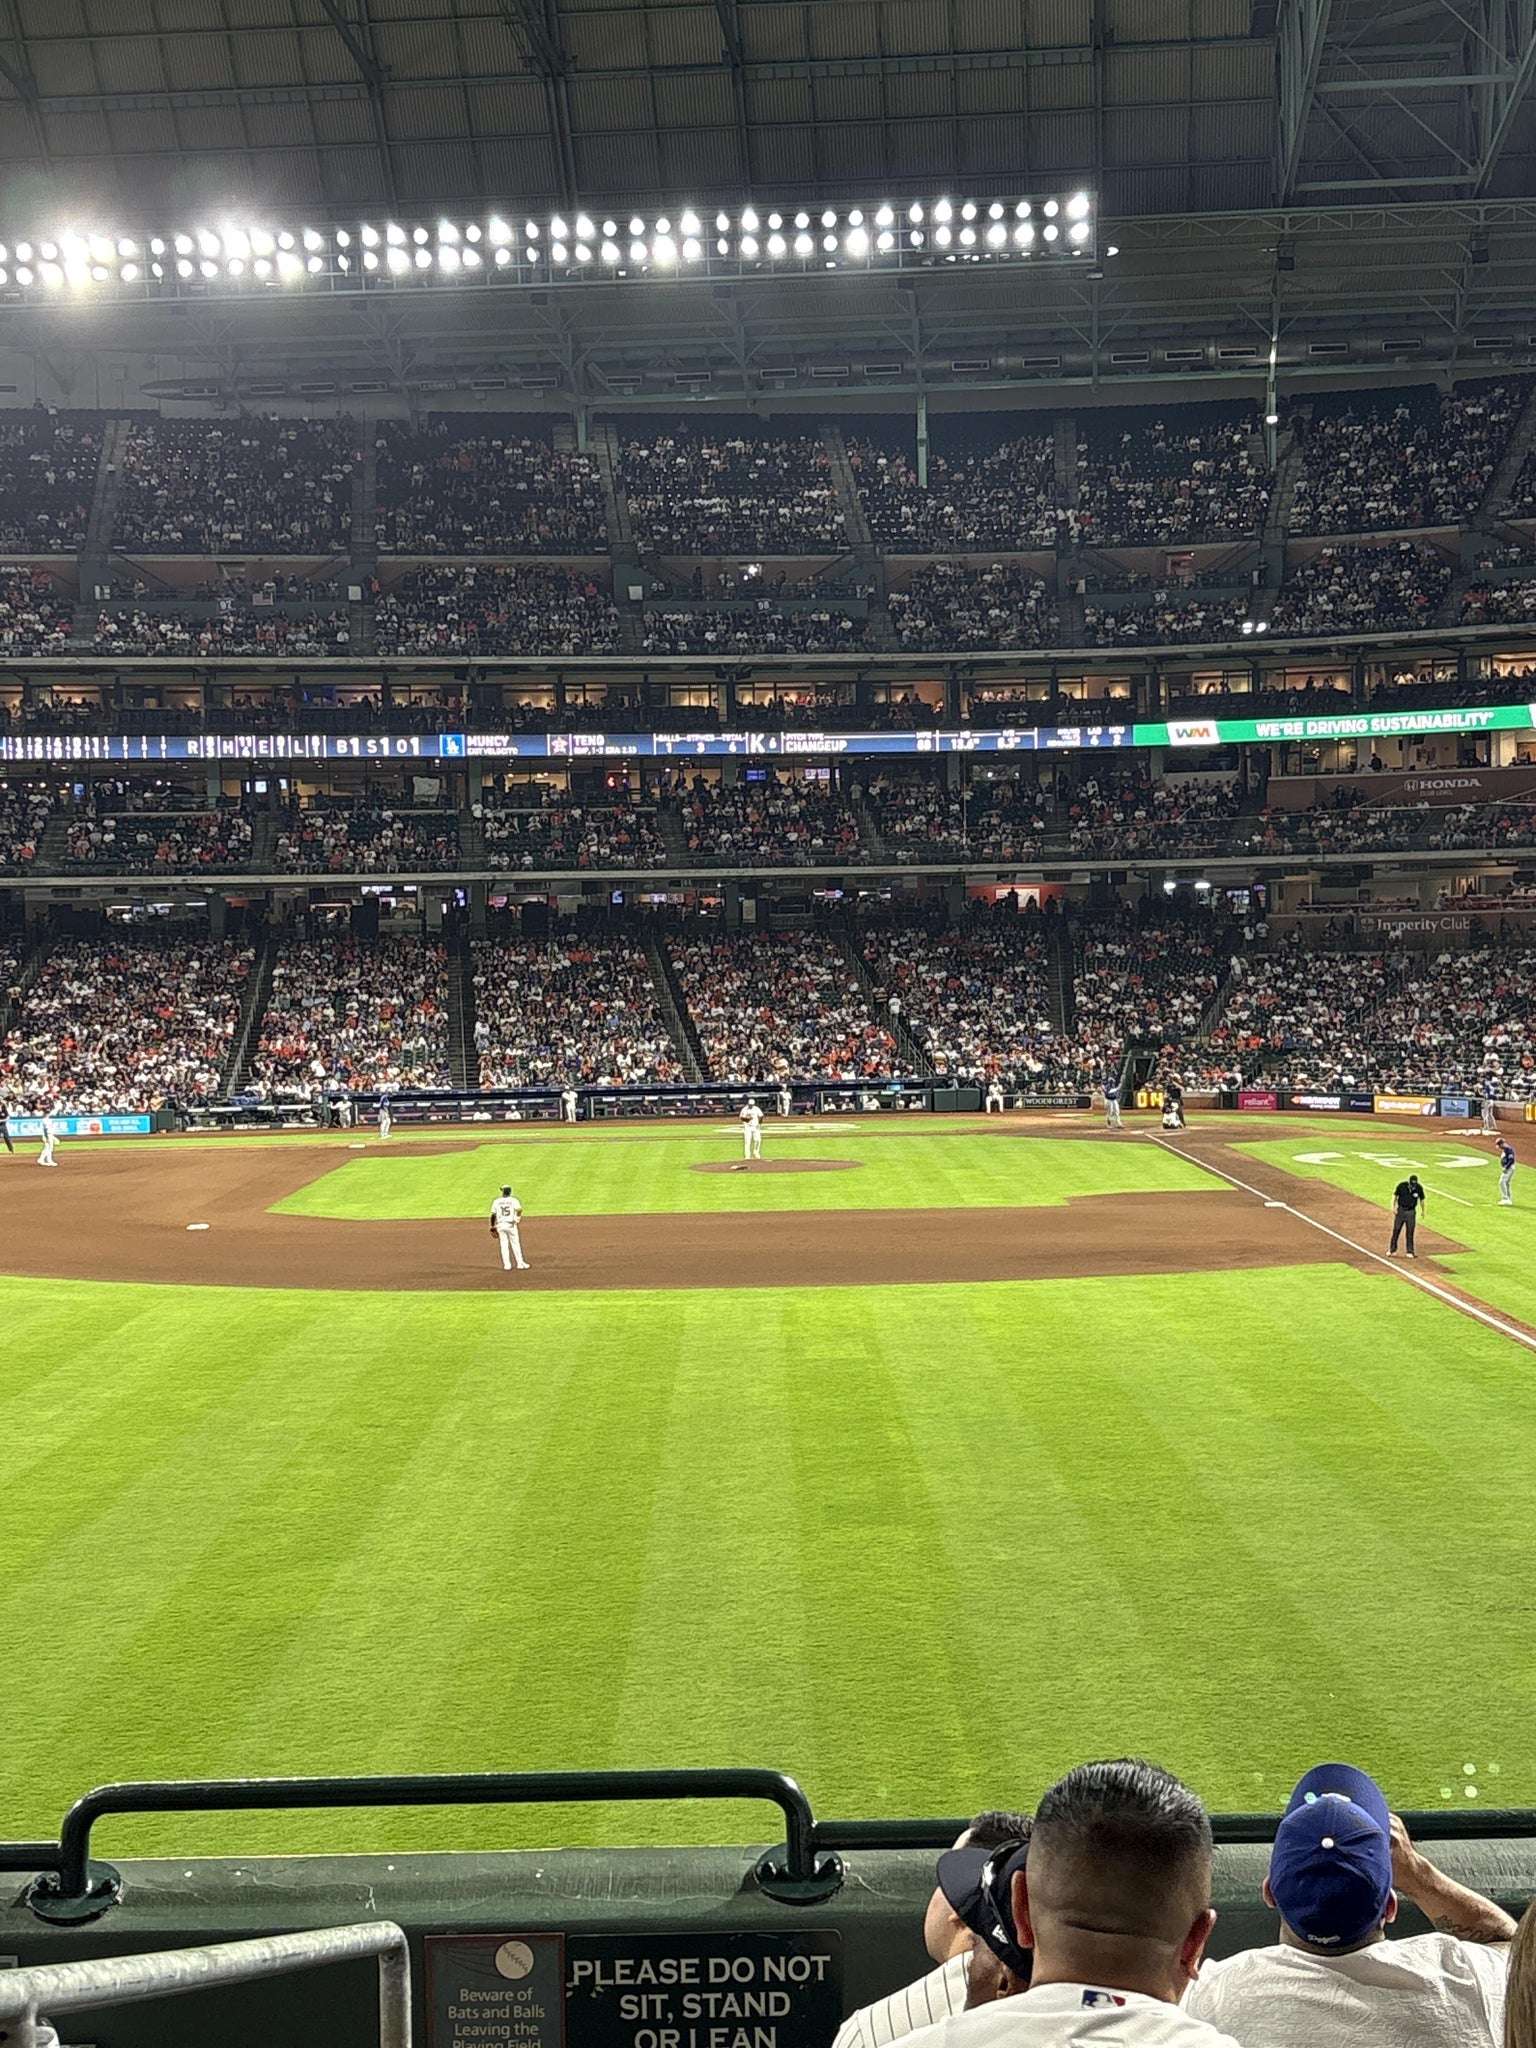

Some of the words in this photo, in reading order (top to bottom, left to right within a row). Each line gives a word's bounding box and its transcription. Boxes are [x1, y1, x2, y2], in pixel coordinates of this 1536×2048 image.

[1154, 592, 1167, 602] 99
[219, 600, 232, 610] 97
[1176, 728, 1210, 738] WM
[1256, 722, 1304, 737] WE'RE
[1307, 719, 1368, 735] DRIVING
[187, 740, 198, 754] R
[223, 740, 234, 754] H
[239, 736, 252, 747] 11
[259, 740, 269, 754] E
[294, 740, 304, 754] L
[337, 739, 347, 754] B
[350, 737, 359, 756] 1
[367, 739, 378, 754] S
[380, 737, 389, 756] 1
[410, 737, 420, 756] 1
[467, 735, 510, 747] MUNCY
[666, 742, 672, 754] 1
[750, 733, 765, 753] K
[786, 740, 848, 752] CHANGEUP
[1420, 779, 1482, 789] HONDA
[1440, 917, 1470, 931] Club
[500, 1206, 510, 1216] 15
[573, 1958, 701, 1986] PLEASE
[708, 1957, 756, 1983] DO
[764, 1955, 831, 1982] NOT
[460, 1989, 513, 2002] Beware
[517, 1987, 534, 2001] of
[448, 2005, 479, 2019] Bats
[482, 2005, 510, 2018] and
[514, 2004, 545, 2019] Balls
[620, 1994, 674, 2024] SIT,
[682, 1991, 792, 2018] STAND
[455, 2023, 510, 2039] Leaving
[514, 2021, 539, 2036] the
[634, 2028, 681, 2048] OR
